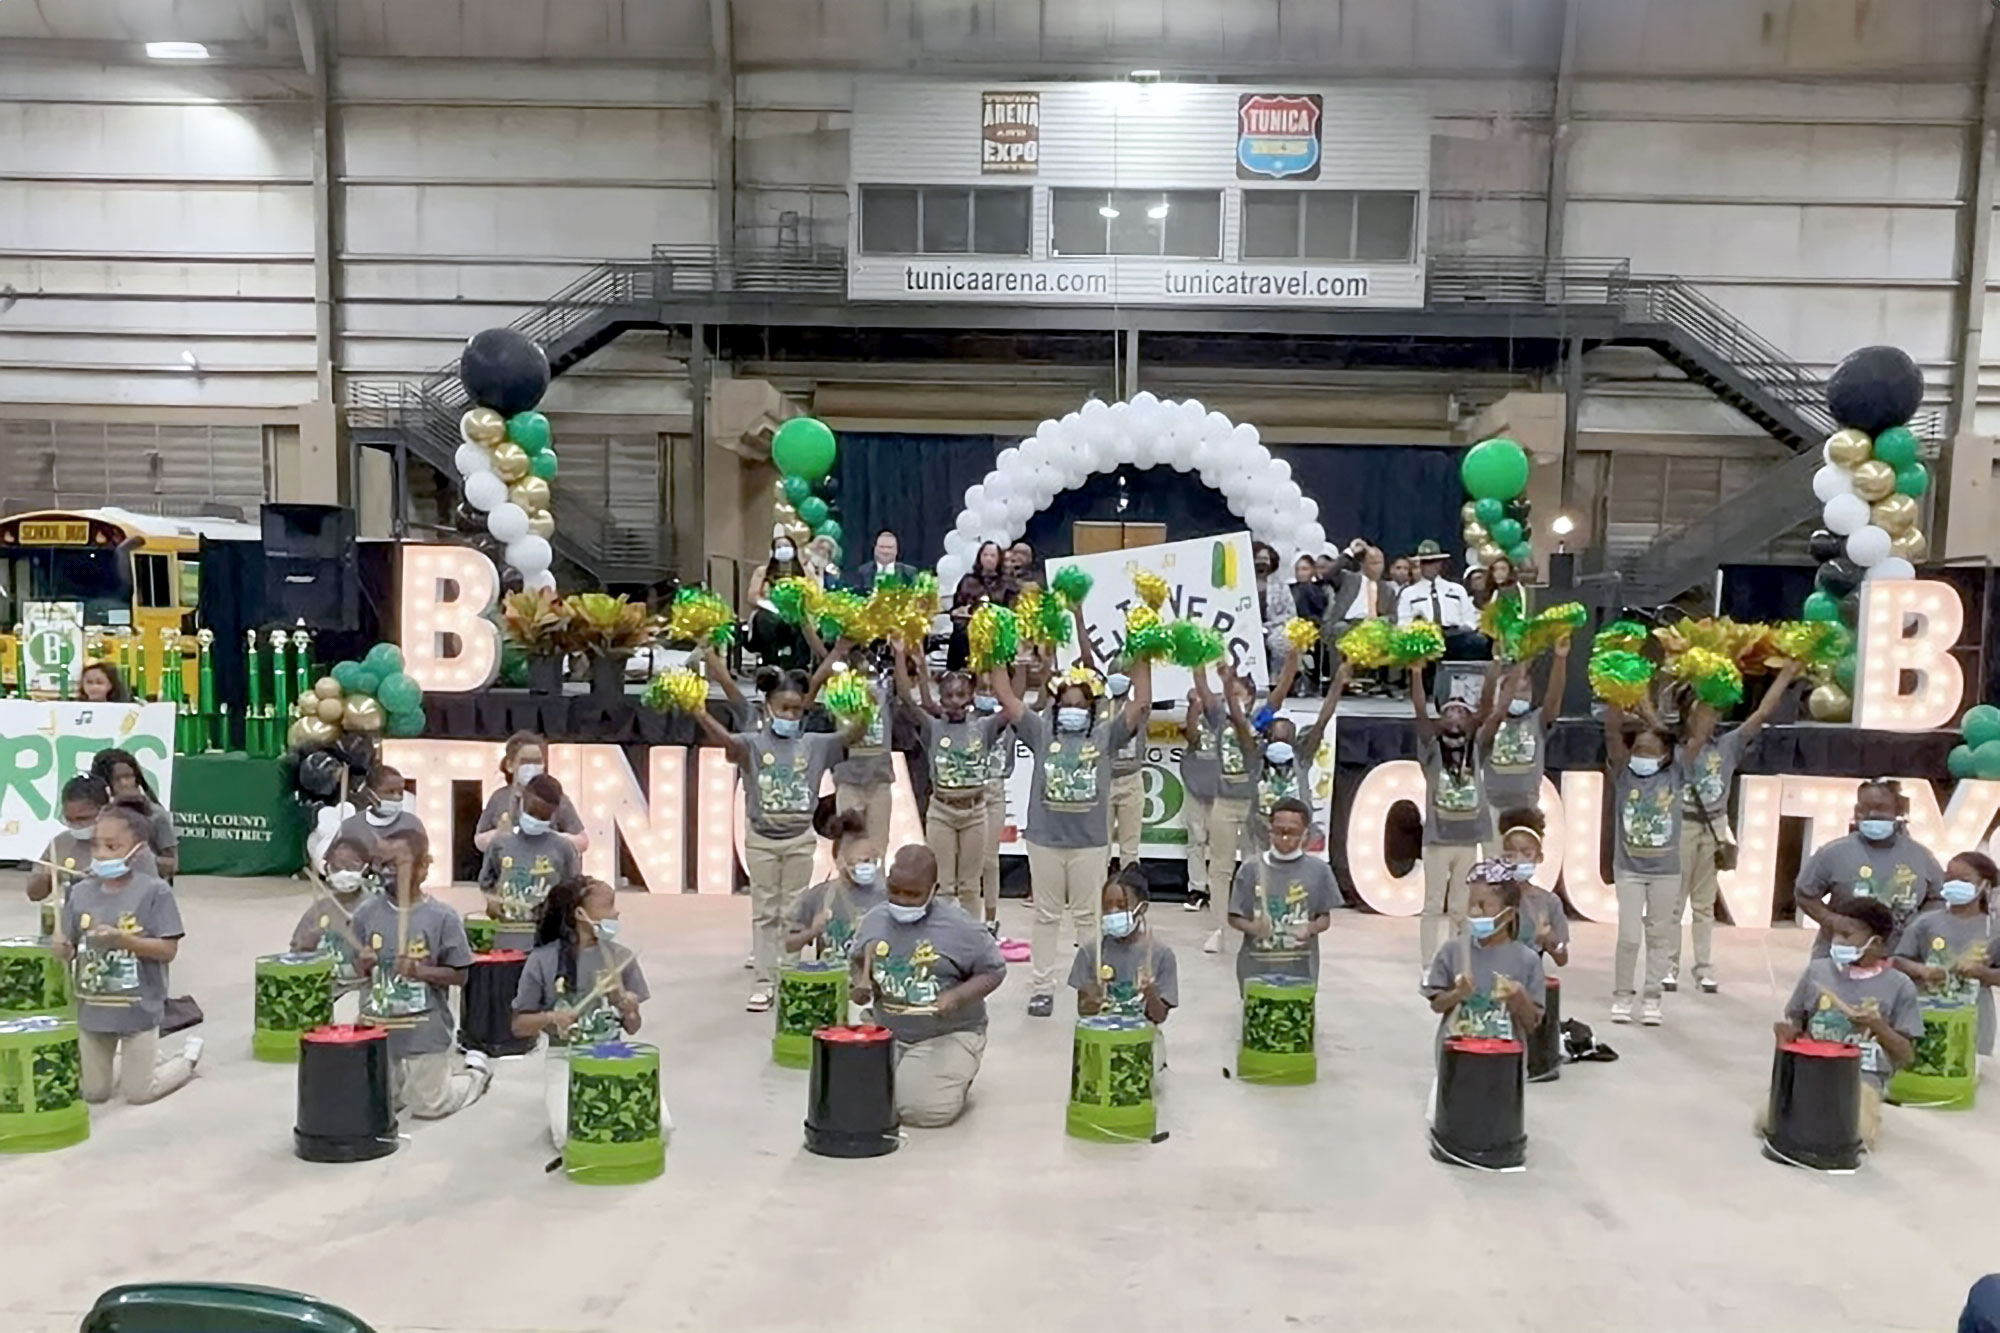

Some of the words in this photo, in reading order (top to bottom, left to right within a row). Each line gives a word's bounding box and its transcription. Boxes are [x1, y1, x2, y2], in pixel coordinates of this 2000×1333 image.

[984, 104, 1038, 127] ARENA
[1248, 109, 1309, 132] TUNICA
[984, 140, 1037, 161] EXPO
[905, 266, 1106, 292] tunicaarena.com
[1165, 269, 1368, 296] tunicatravel.com
[401, 545, 499, 691] B
[1859, 580, 1964, 730] B
[213, 814, 267, 828] COUNTY
[211, 828, 273, 842] DISTRICT
